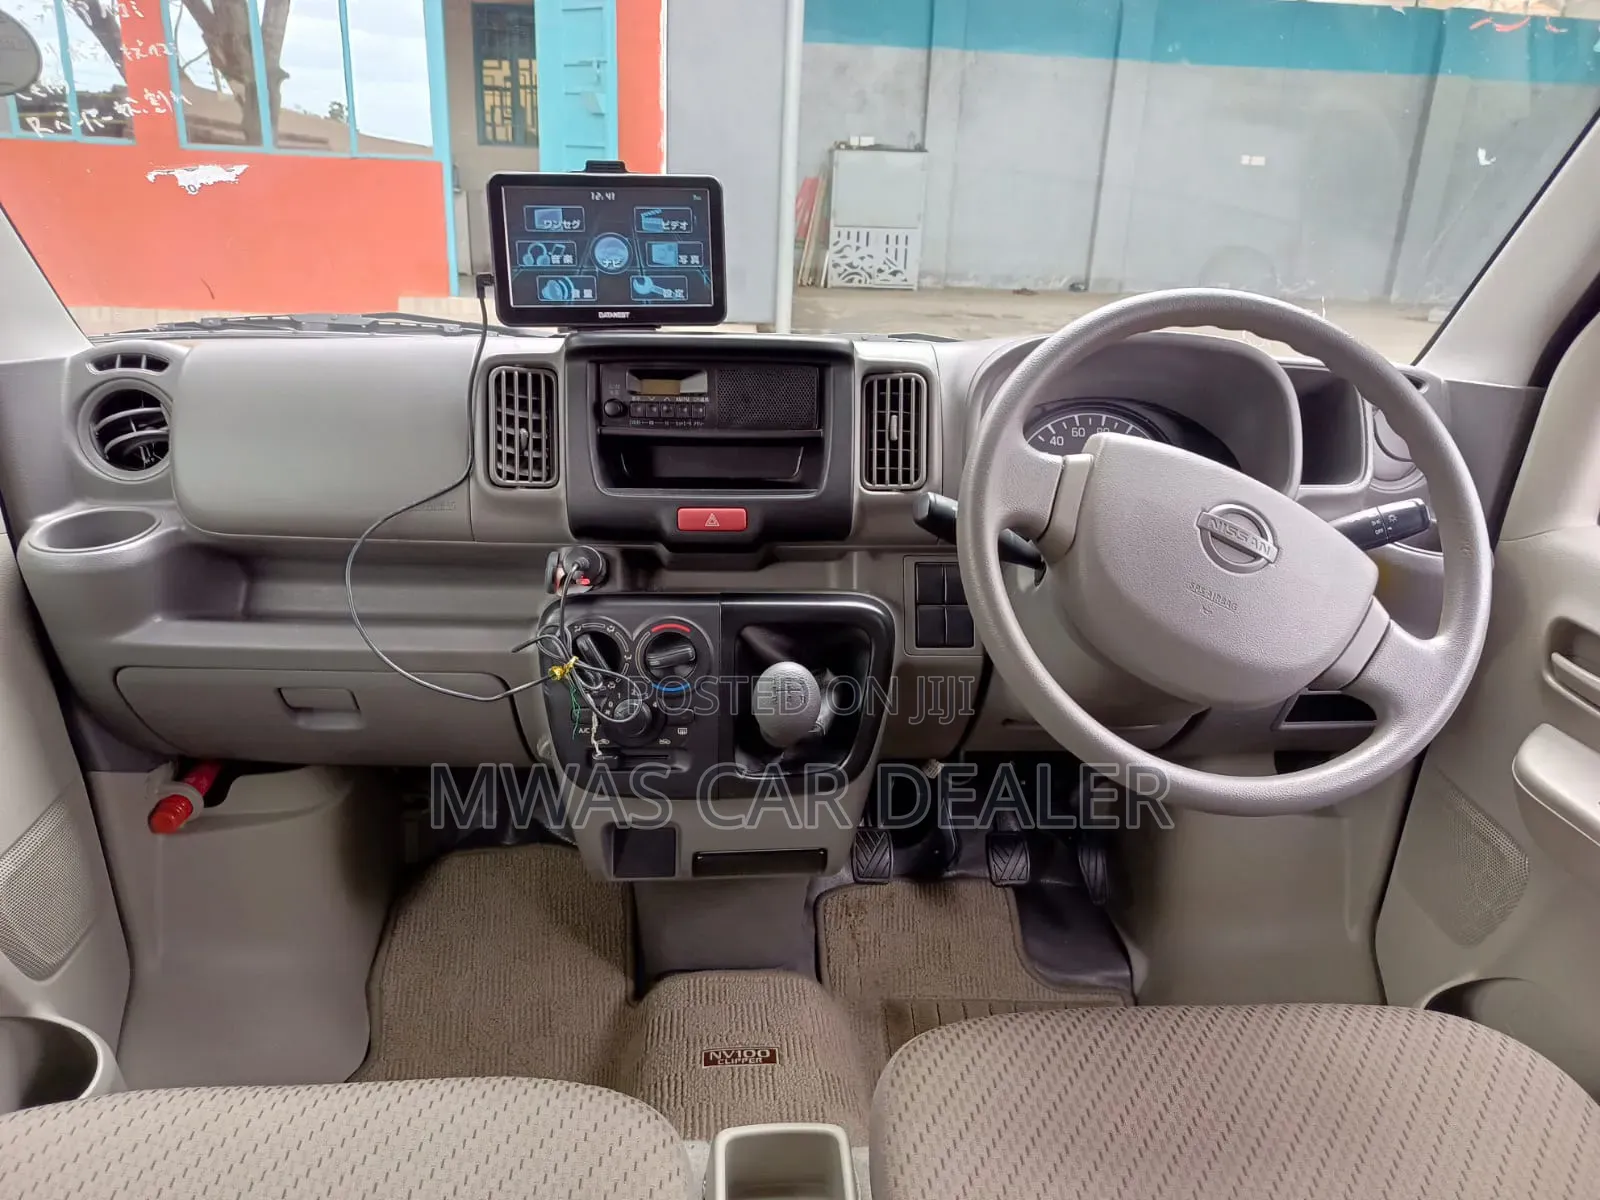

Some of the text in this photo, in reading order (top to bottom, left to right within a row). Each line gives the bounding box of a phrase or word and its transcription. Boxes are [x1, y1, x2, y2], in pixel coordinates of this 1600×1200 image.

[543, 219, 581, 230] ワンセグ
[662, 219, 689, 231] ビデオ
[550, 254, 574, 265] 音楽
[601, 257, 623, 268] ナビ
[678, 254, 700, 265] 写真
[1071, 427, 1086, 437] 60
[1049, 436, 1064, 446] 40
[1207, 518, 1271, 556] NISSAN
[709, 1049, 770, 1061] NV100
[717, 1057, 762, 1065] CLIPPER
